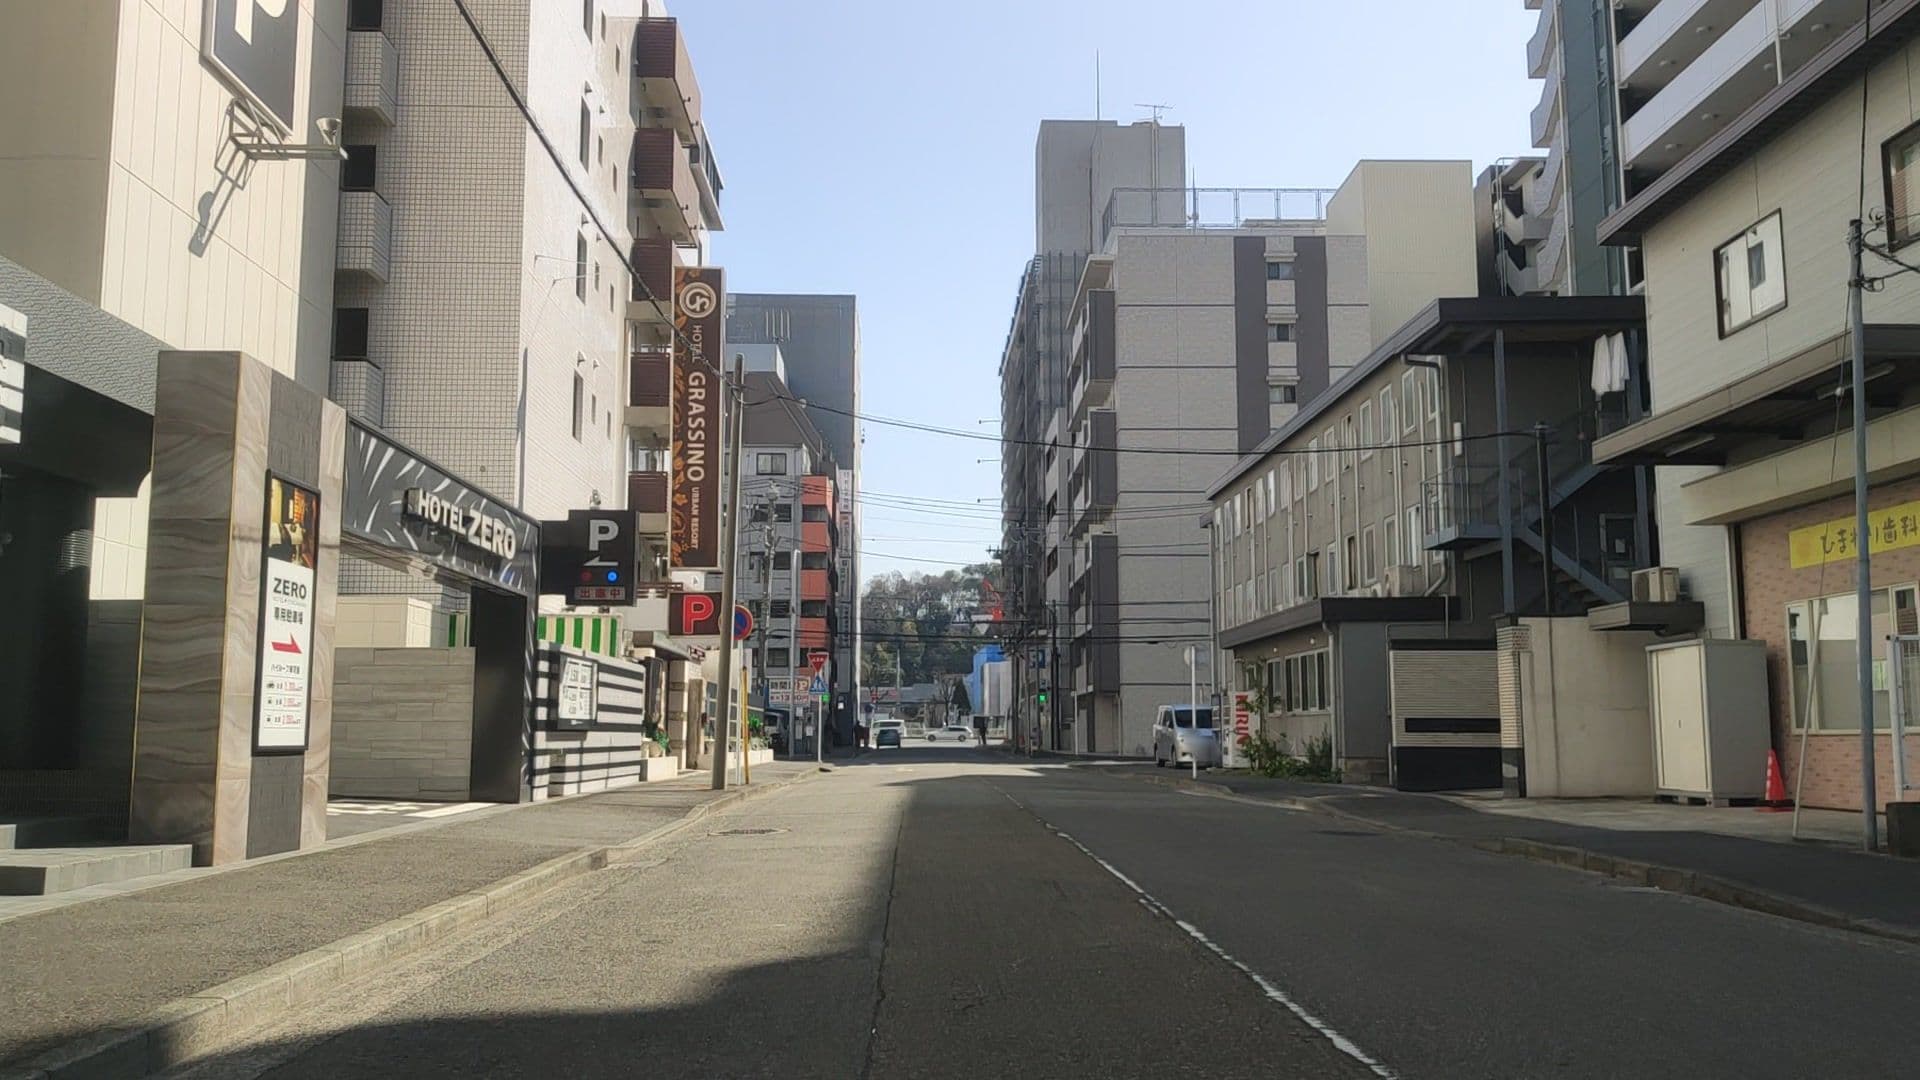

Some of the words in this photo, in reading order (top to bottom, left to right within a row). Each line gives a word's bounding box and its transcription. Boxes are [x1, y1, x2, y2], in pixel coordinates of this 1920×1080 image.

[692, 325, 702, 362] HOTEL
[687, 371, 706, 482] GRASSINO
[691, 486, 700, 517] URBAN
[418, 487, 467, 535] HOTEL
[467, 508, 516, 560] ZERO
[589, 519, 619, 551] P
[273, 577, 307, 599] ZERO
[683, 594, 714, 635] P
